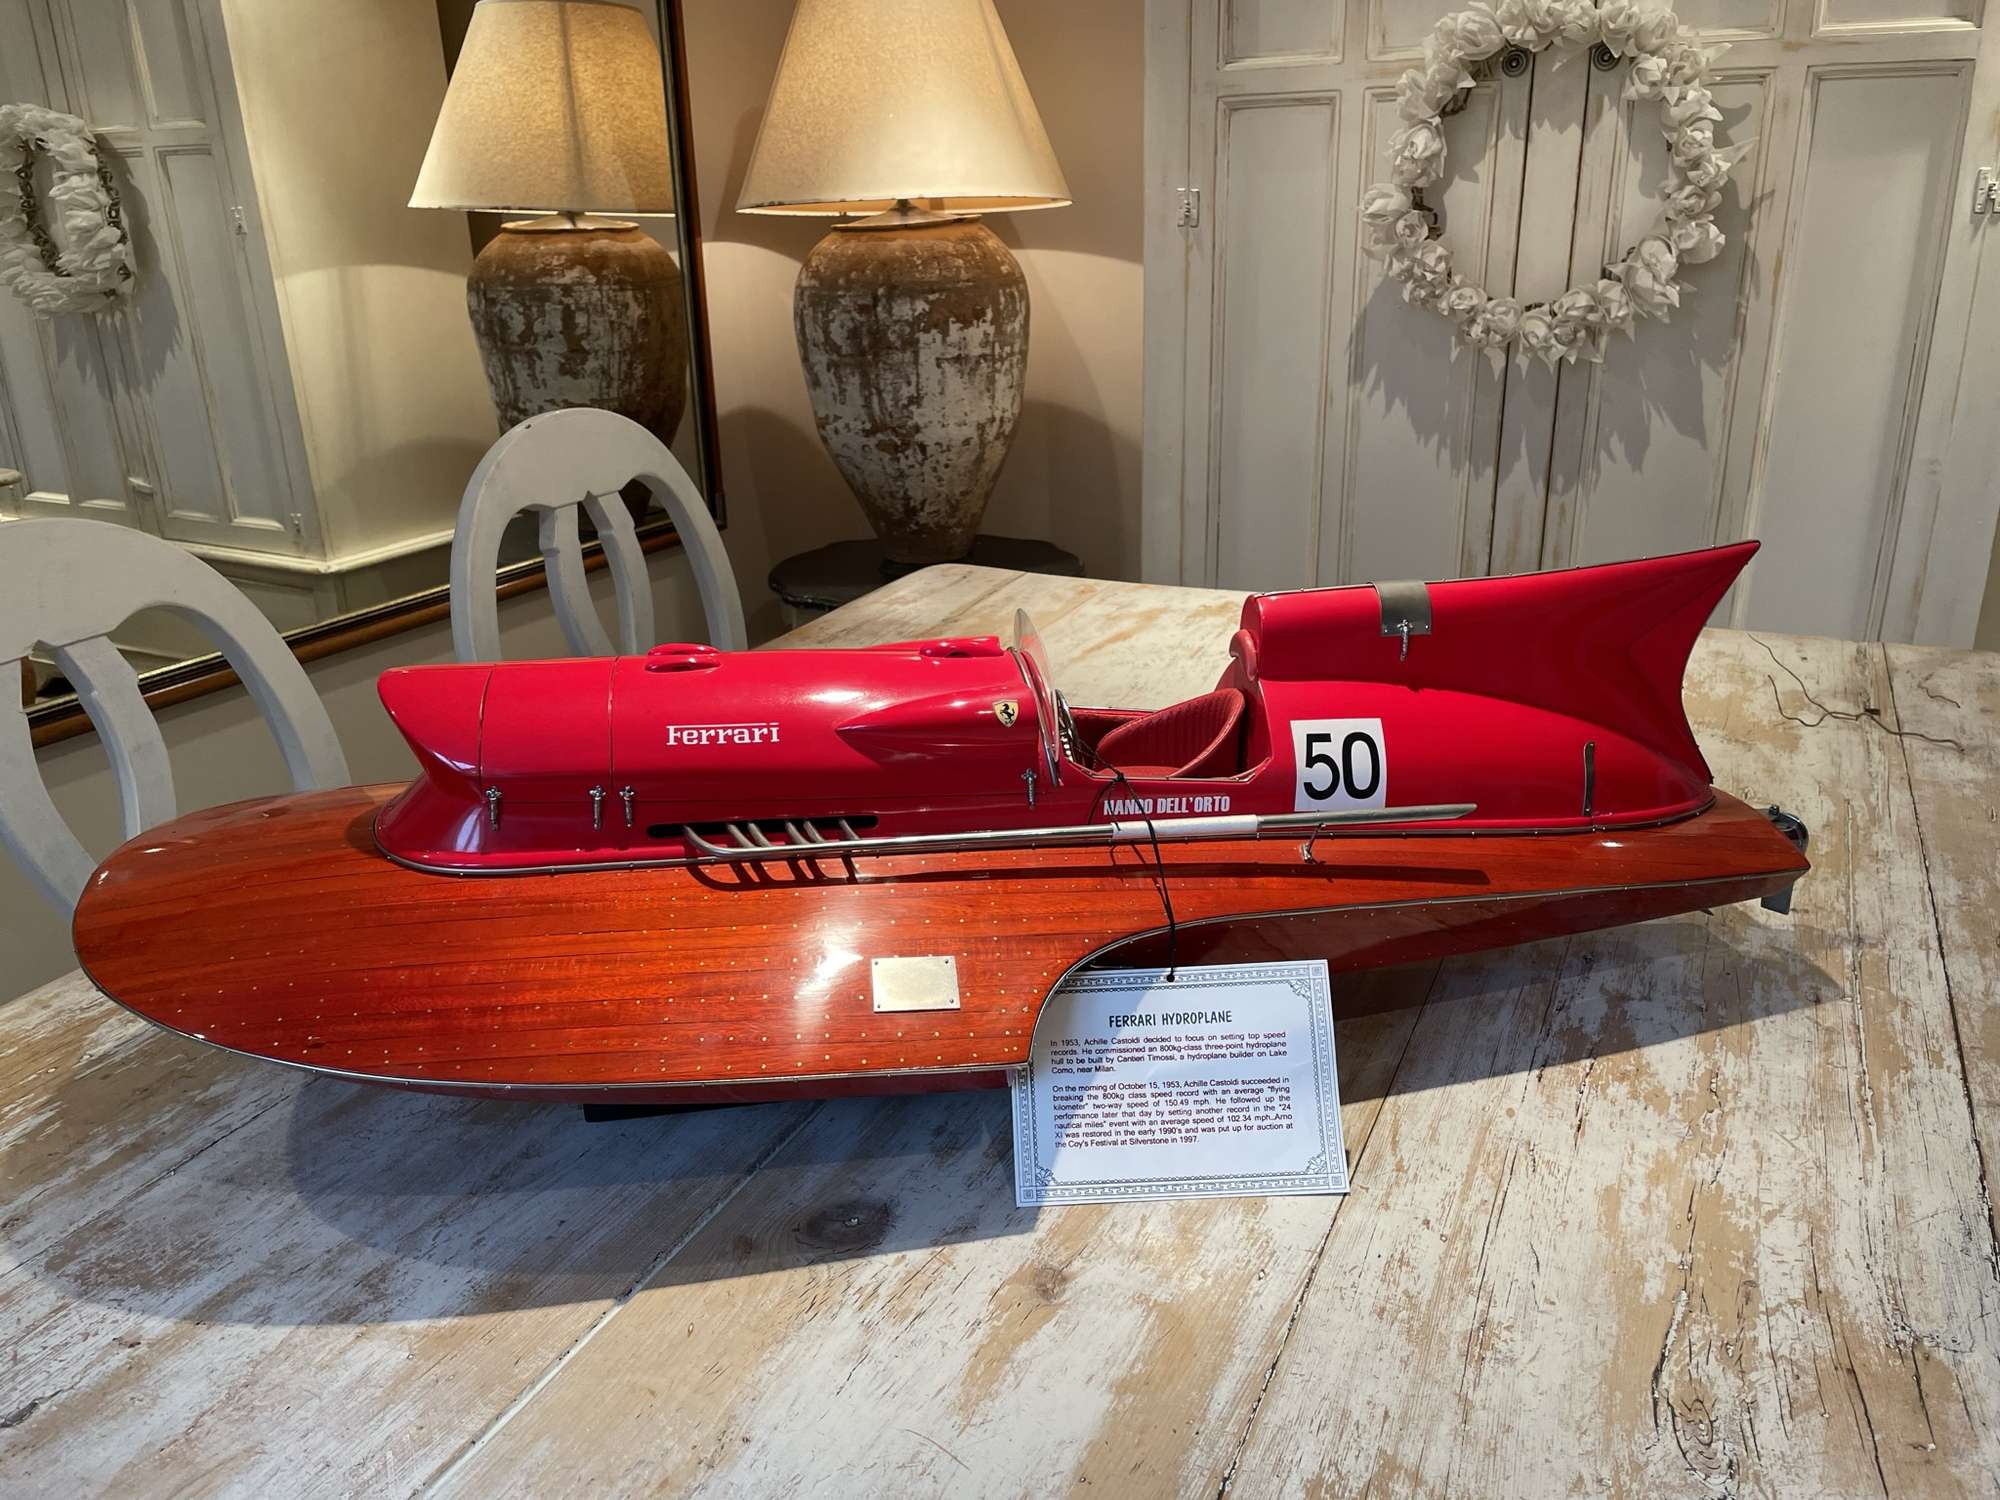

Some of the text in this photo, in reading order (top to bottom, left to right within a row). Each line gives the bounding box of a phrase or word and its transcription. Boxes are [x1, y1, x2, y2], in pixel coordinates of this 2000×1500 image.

[666, 722, 780, 746] Ferrari
[1303, 731, 1380, 801] 50
[1156, 796, 1231, 814] DELL'ORTO
[1108, 1010, 1232, 1027] FERRARI HYDROPLANE
[1061, 1038, 1080, 1047] 1953,
[1110, 1036, 1140, 1044] Castoldi
[1143, 1035, 1171, 1043] decided
[1220, 1032, 1244, 1042] setting
[1247, 1031, 1260, 1041] top
[1263, 1030, 1286, 1040] speed
[1094, 1044, 1145, 1053] commissioned
[1159, 1042, 1202, 1053] 800kg-class
[1204, 1041, 1243, 1051] three-point
[1245, 1039, 1286, 1050] hydroplane
[1105, 1055, 1113, 1064] by
[1147, 1052, 1177, 1061] Timossi,
[1187, 1051, 1226, 1061] hydroplane
[1051, 1065, 1075, 1074] Como,
[1078, 1082, 1107, 1092] morning
[1118, 1081, 1146, 1089] October
[1149, 1080, 1160, 1089] 15,
[1162, 1080, 1181, 1088] 1953,
[1209, 1078, 1239, 1086] Castoldi
[1240, 1076, 1280, 1084] succeeded
[1052, 1092, 1083, 1102] breaking
[1102, 1091, 1124, 1100] 800kg
[1150, 1089, 1172, 1099] speed
[1234, 1087, 1264, 1096] average
[1266, 1085, 1290, 1094] "flying
[1053, 1101, 1088, 1110] kilometer"
[1092, 1100, 1122, 1110] two-way
[1126, 1099, 1148, 1109] speed
[1230, 1095, 1260, 1103] followed
[1053, 1110, 1098, 1120] performance
[1138, 1108, 1152, 1117] day
[1155, 1108, 1164, 1117] by
[1167, 1107, 1192, 1116] setting
[1195, 1105, 1222, 1113] another
[1054, 1120, 1082, 1128] nautical
[1160, 1118, 1190, 1126] average
[1191, 1115, 1214, 1125] speed
[1082, 1128, 1112, 1136] restored
[1137, 1127, 1155, 1136] early
[1218, 1124, 1229, 1133] put
[1256, 1122, 1283, 1130] auction
[1068, 1138, 1088, 1148] Coy's
[1090, 1137, 1118, 1145] Festival
[1129, 1136, 1169, 1144] Silverstone
